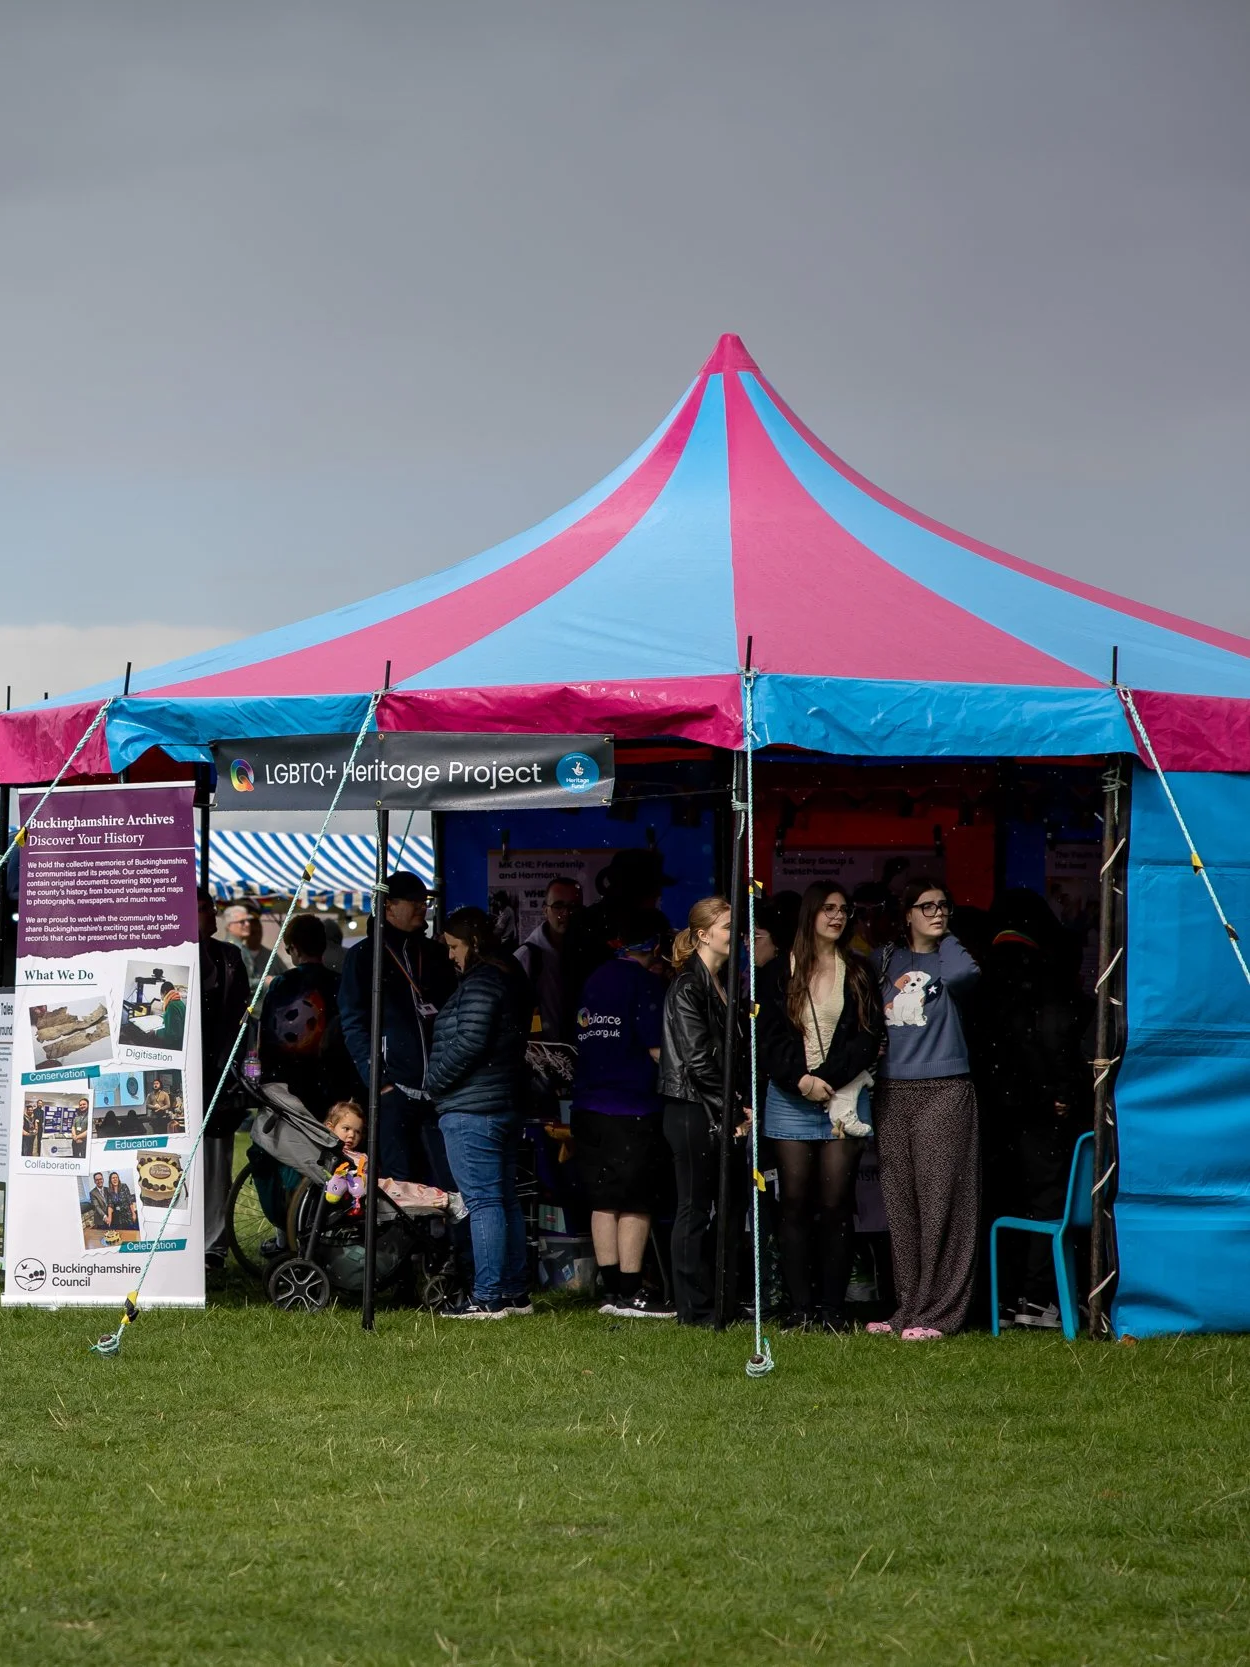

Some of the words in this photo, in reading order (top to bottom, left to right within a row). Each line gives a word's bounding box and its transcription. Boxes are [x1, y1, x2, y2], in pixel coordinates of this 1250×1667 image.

[265, 761, 337, 787] LGBTQ+
[343, 758, 440, 789] Heritage
[449, 761, 542, 790] Project
[566, 777, 590, 785] Heritage
[29, 816, 125, 831] Buckinghamshire
[127, 814, 174, 826] Archives
[29, 835, 75, 846] Discover
[77, 834, 102, 845] Your
[104, 833, 144, 846] History
[135, 858, 188, 866] Buckinghamshire,
[537, 860, 585, 871] Friendship
[98, 869, 121, 877] people.
[136, 867, 169, 875] collections
[499, 871, 517, 879] and
[51, 879, 75, 887] original
[76, 878, 109, 886] documents
[110, 878, 138, 886] covering
[152, 877, 169, 885] years
[66, 888, 88, 896] history,
[33, 898, 76, 907] photographs,
[77, 897, 114, 905] newspapers,
[48, 916, 68, 924] proud
[119, 914, 156, 923] community
[164, 914, 178, 922] help
[103, 924, 128, 932] exciting
[129, 924, 145, 932] past,
[160, 923, 180, 932] gather
[87, 933, 117, 941] preserved
[24, 970, 54, 981] What
[58, 970, 75, 980] We
[78, 970, 94, 980] Do
[126, 1048, 173, 1062] Digitisation
[29, 1069, 86, 1082] Conservation
[115, 1140, 158, 1150] Education
[24, 1159, 81, 1170] Collaboration
[126, 1241, 177, 1251] Celebation
[52, 1263, 141, 1277] Buckinghamshire
[52, 1277, 91, 1287] Council
